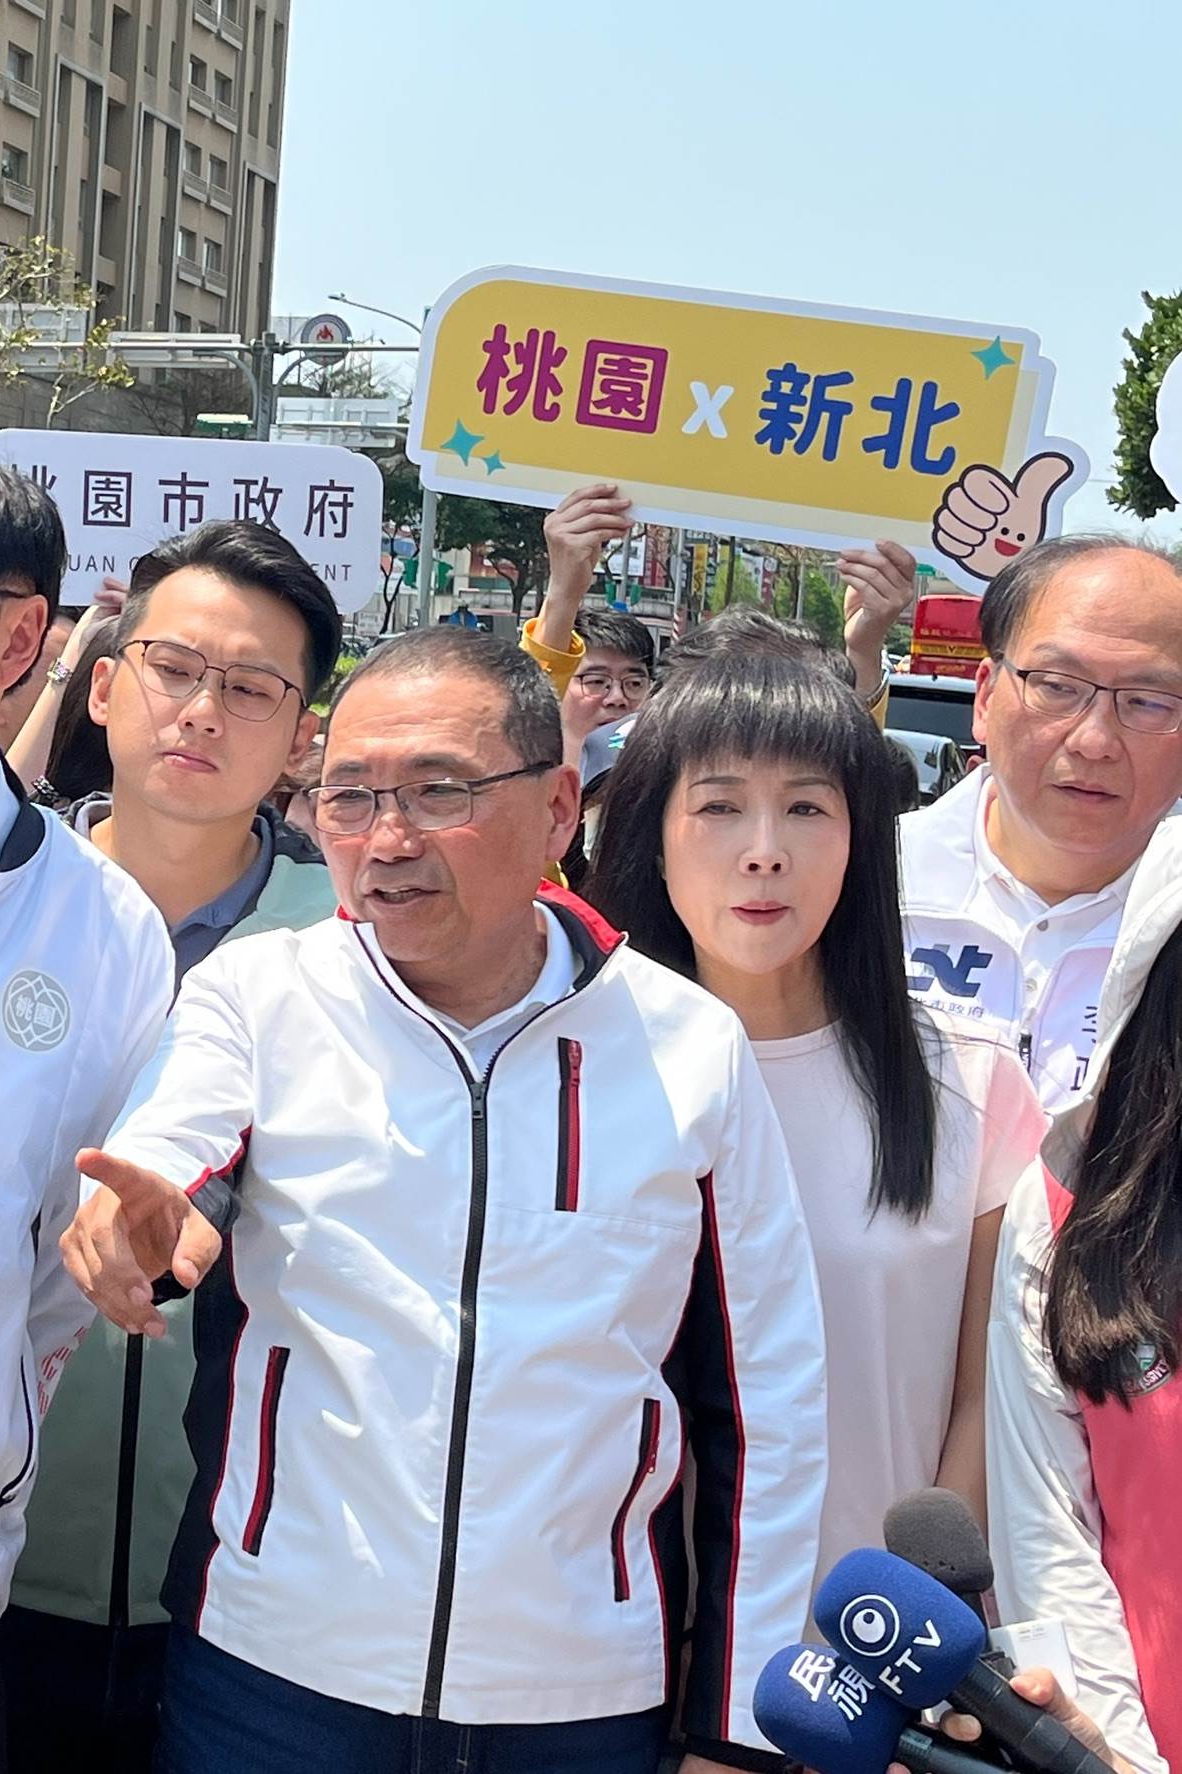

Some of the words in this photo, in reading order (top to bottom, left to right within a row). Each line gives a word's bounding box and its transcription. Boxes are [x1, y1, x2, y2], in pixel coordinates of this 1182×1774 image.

[476, 323, 669, 435] 桃園
[754, 362, 962, 477] 新北
[68, 554, 116, 573] UAN
[788, 1649, 876, 1721] 民視
[879, 1619, 943, 1695] FTV
